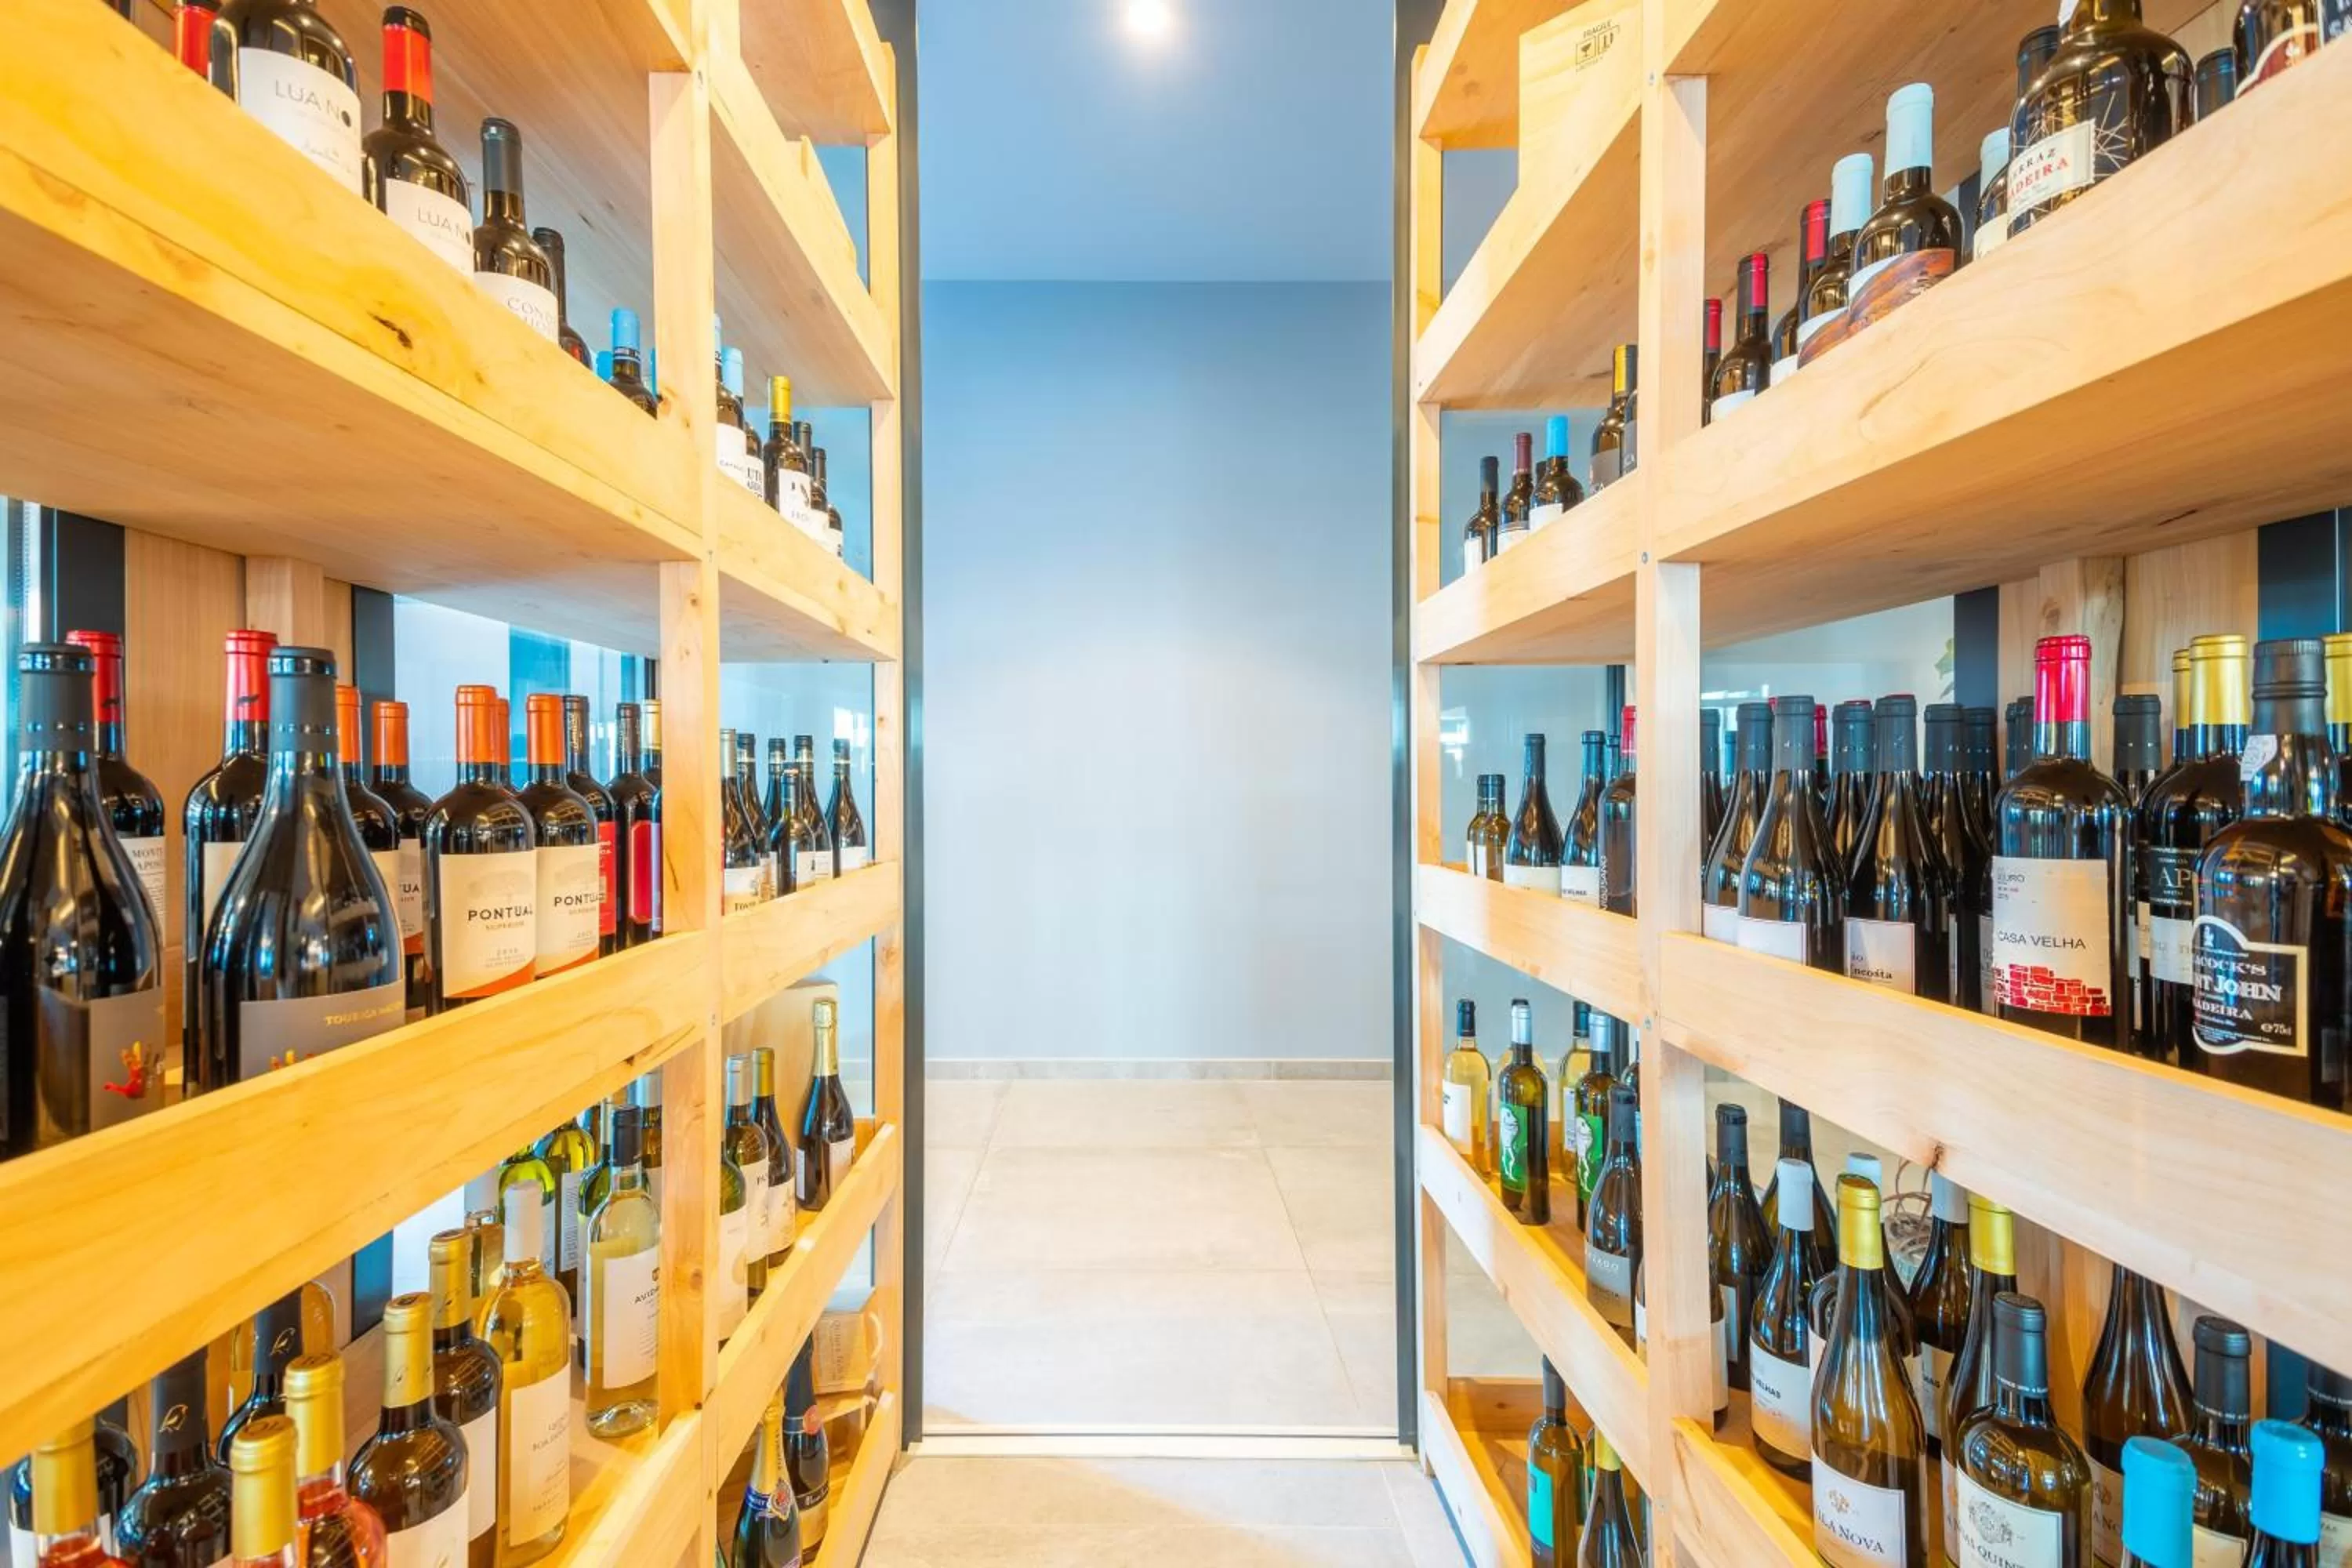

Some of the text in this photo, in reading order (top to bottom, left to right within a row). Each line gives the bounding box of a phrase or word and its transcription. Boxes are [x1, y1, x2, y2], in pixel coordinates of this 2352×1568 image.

[2030, 935, 2087, 950] VELHA
[2214, 975, 2283, 1002] JOHN
[1838, 1524, 1886, 1555] NOVA
